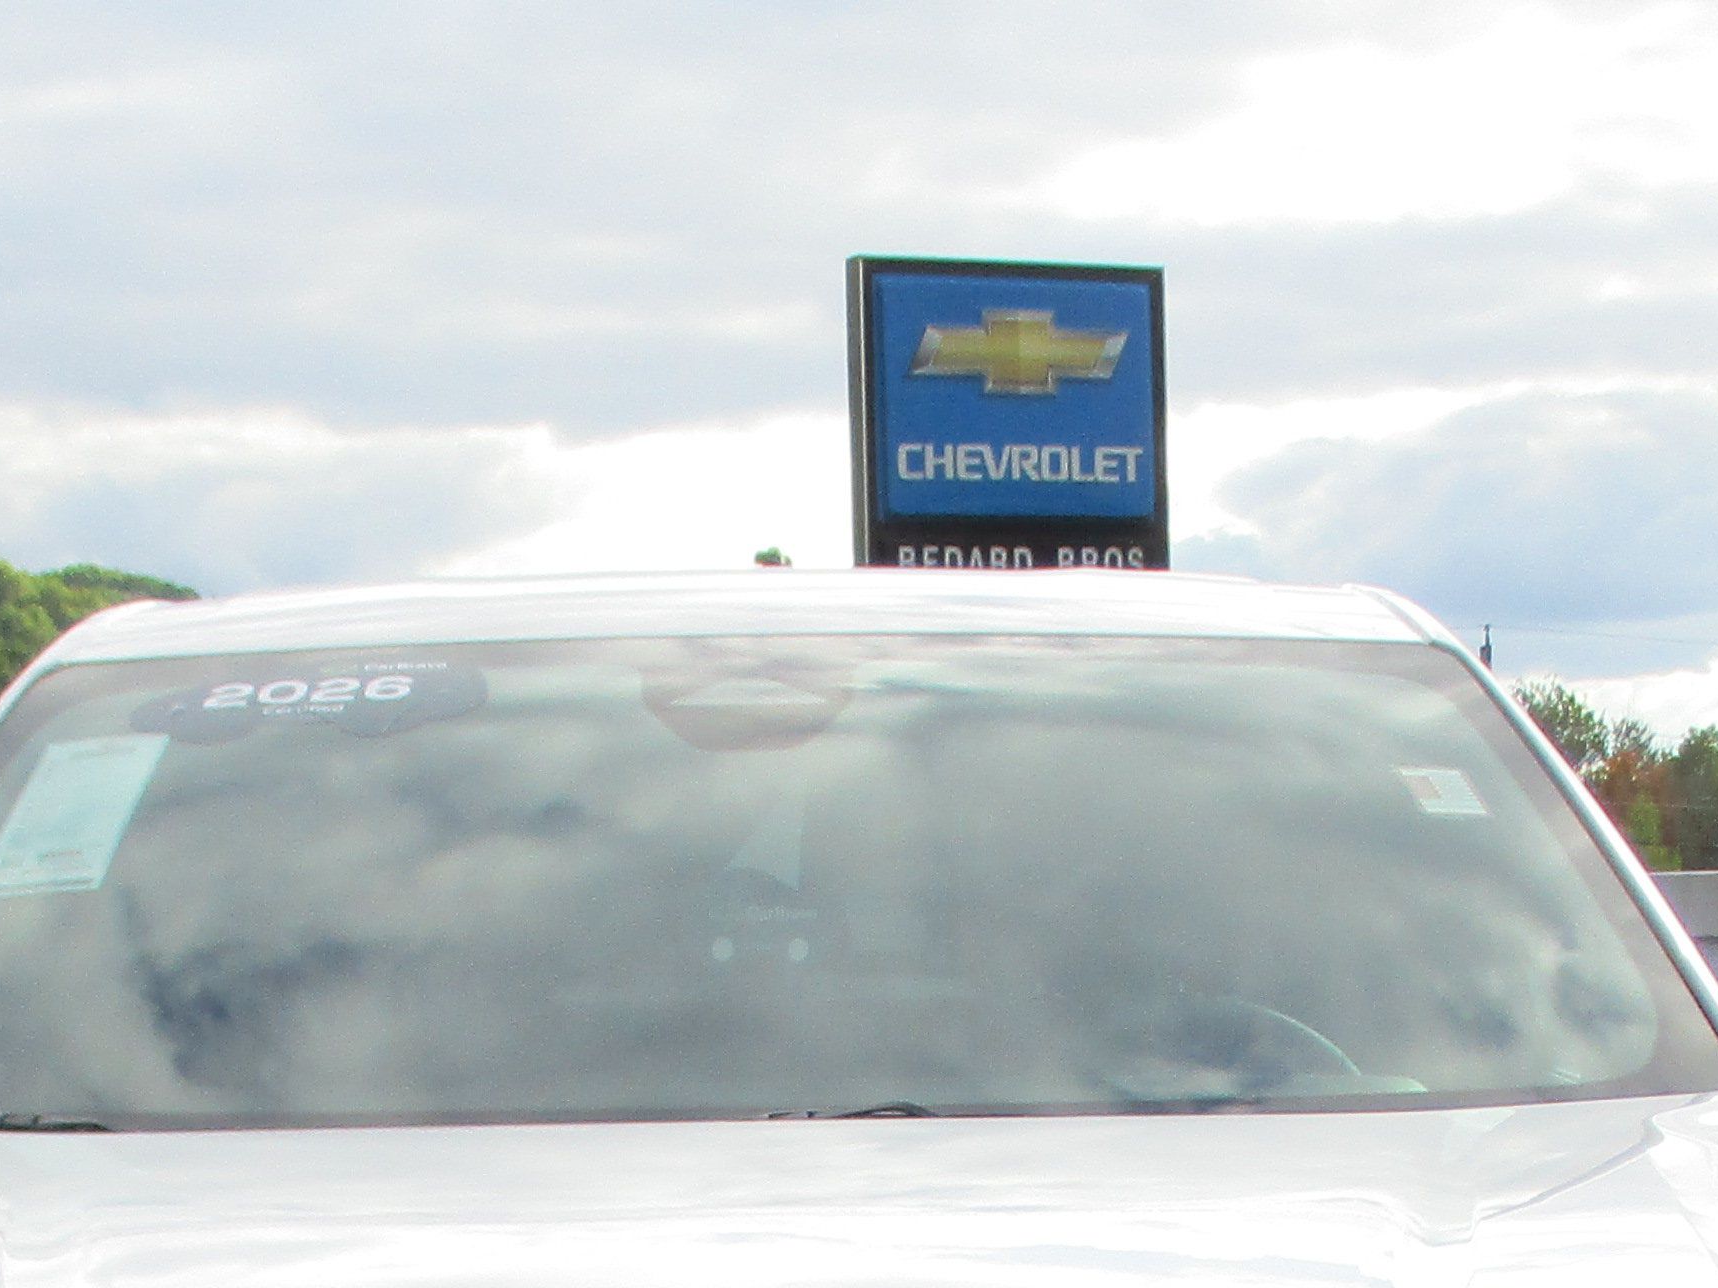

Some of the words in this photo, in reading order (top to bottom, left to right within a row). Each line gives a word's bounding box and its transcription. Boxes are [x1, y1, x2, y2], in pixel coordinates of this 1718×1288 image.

[896, 441, 1144, 484] CHEVROLET
[898, 544, 1033, 568] BEDARD
[1057, 545, 1144, 569] BROS
[202, 674, 414, 711] 2026
